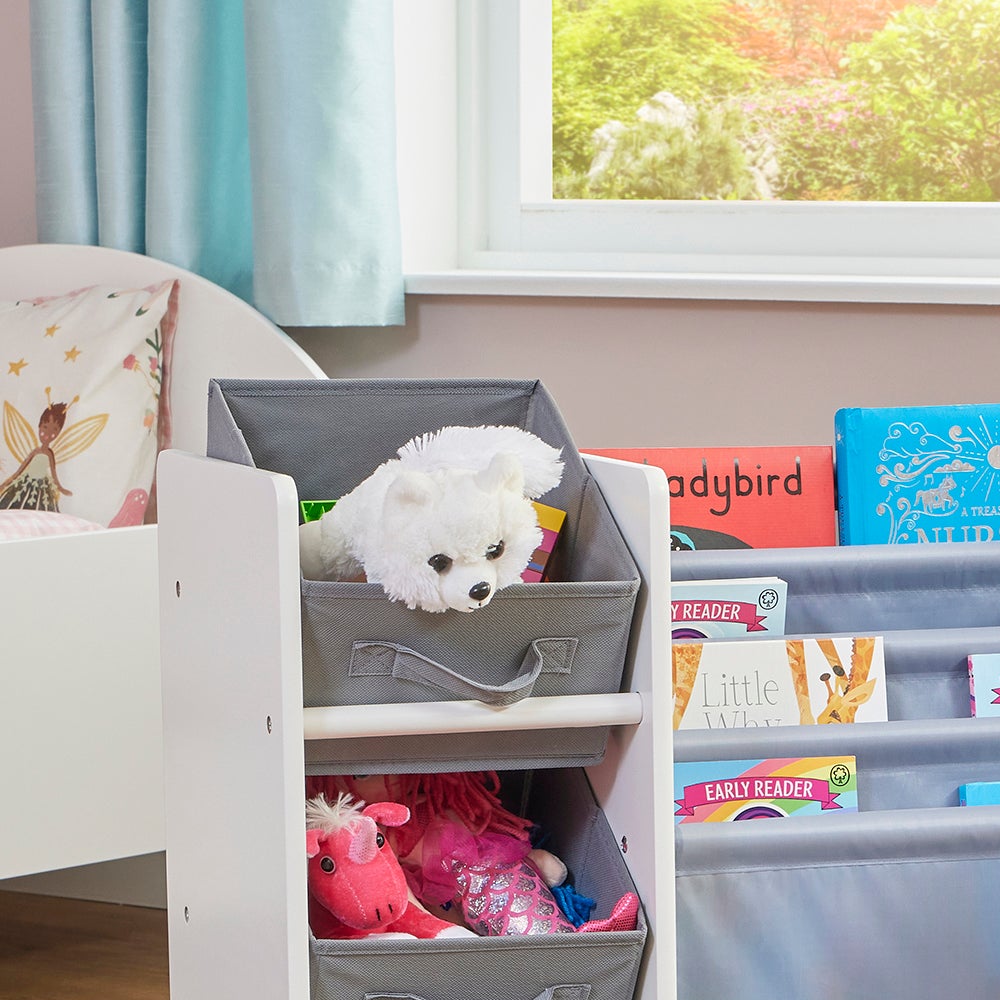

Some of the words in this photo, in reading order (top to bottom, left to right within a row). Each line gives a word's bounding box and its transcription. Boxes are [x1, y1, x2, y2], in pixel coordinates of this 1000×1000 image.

[642, 456, 803, 517] adybird
[961, 507, 969, 517] A
[682, 603, 742, 620] READER
[702, 670, 780, 708] Little
[704, 781, 751, 801] EARLY
[754, 780, 814, 798] READER
